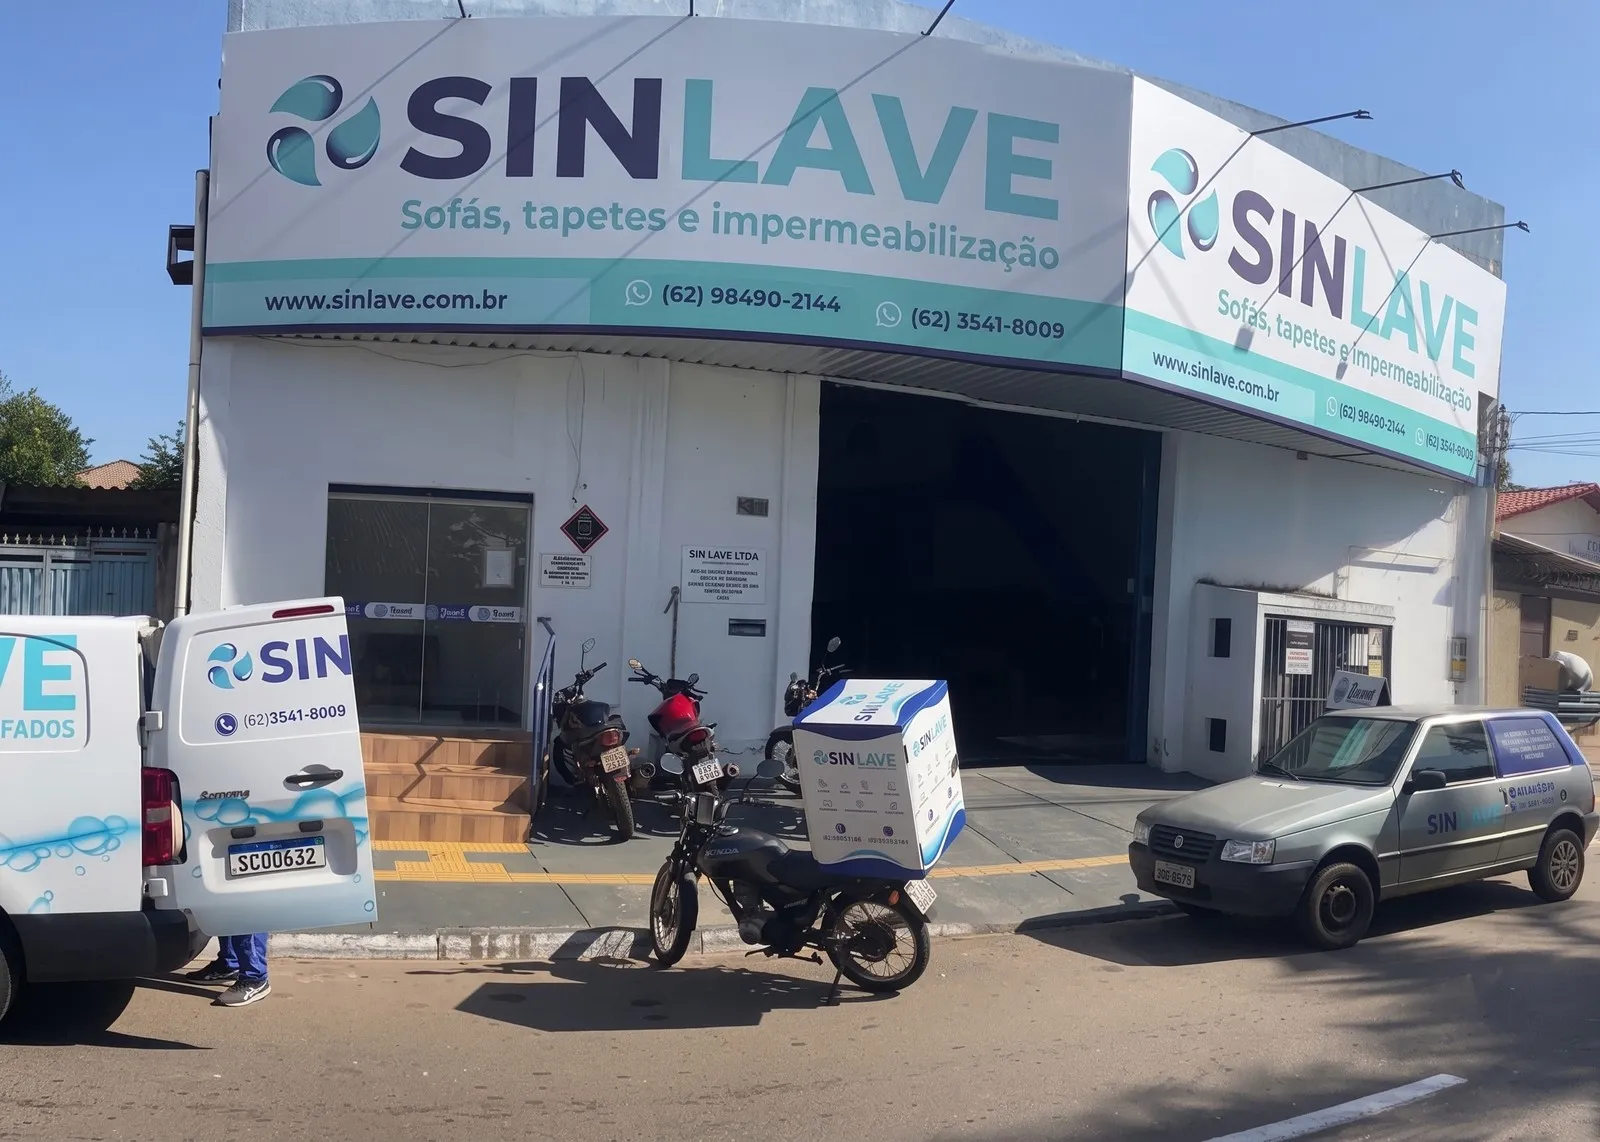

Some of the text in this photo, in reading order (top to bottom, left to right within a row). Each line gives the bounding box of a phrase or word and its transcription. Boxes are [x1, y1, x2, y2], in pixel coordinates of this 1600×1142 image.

[400, 76, 1060, 221] SINLAVE
[401, 197, 1060, 273] Sofás, tapetes e impermeabilização
[265, 289, 508, 312] www.sinlave.com.br
[662, 284, 842, 313] (62) 98490-2144
[1227, 189, 1479, 380] SINLAVE
[911, 307, 1065, 340] (62) 3541-8009
[1217, 288, 1472, 413] Sofás, tapetes e impermeabilização
[1152, 351, 1281, 403] www.sinlave.com.br
[1339, 402, 1406, 437] (62) 98490-2144
[1425, 432, 1440, 449] (62)
[689, 549, 759, 561] SIN LAVE LTDA
